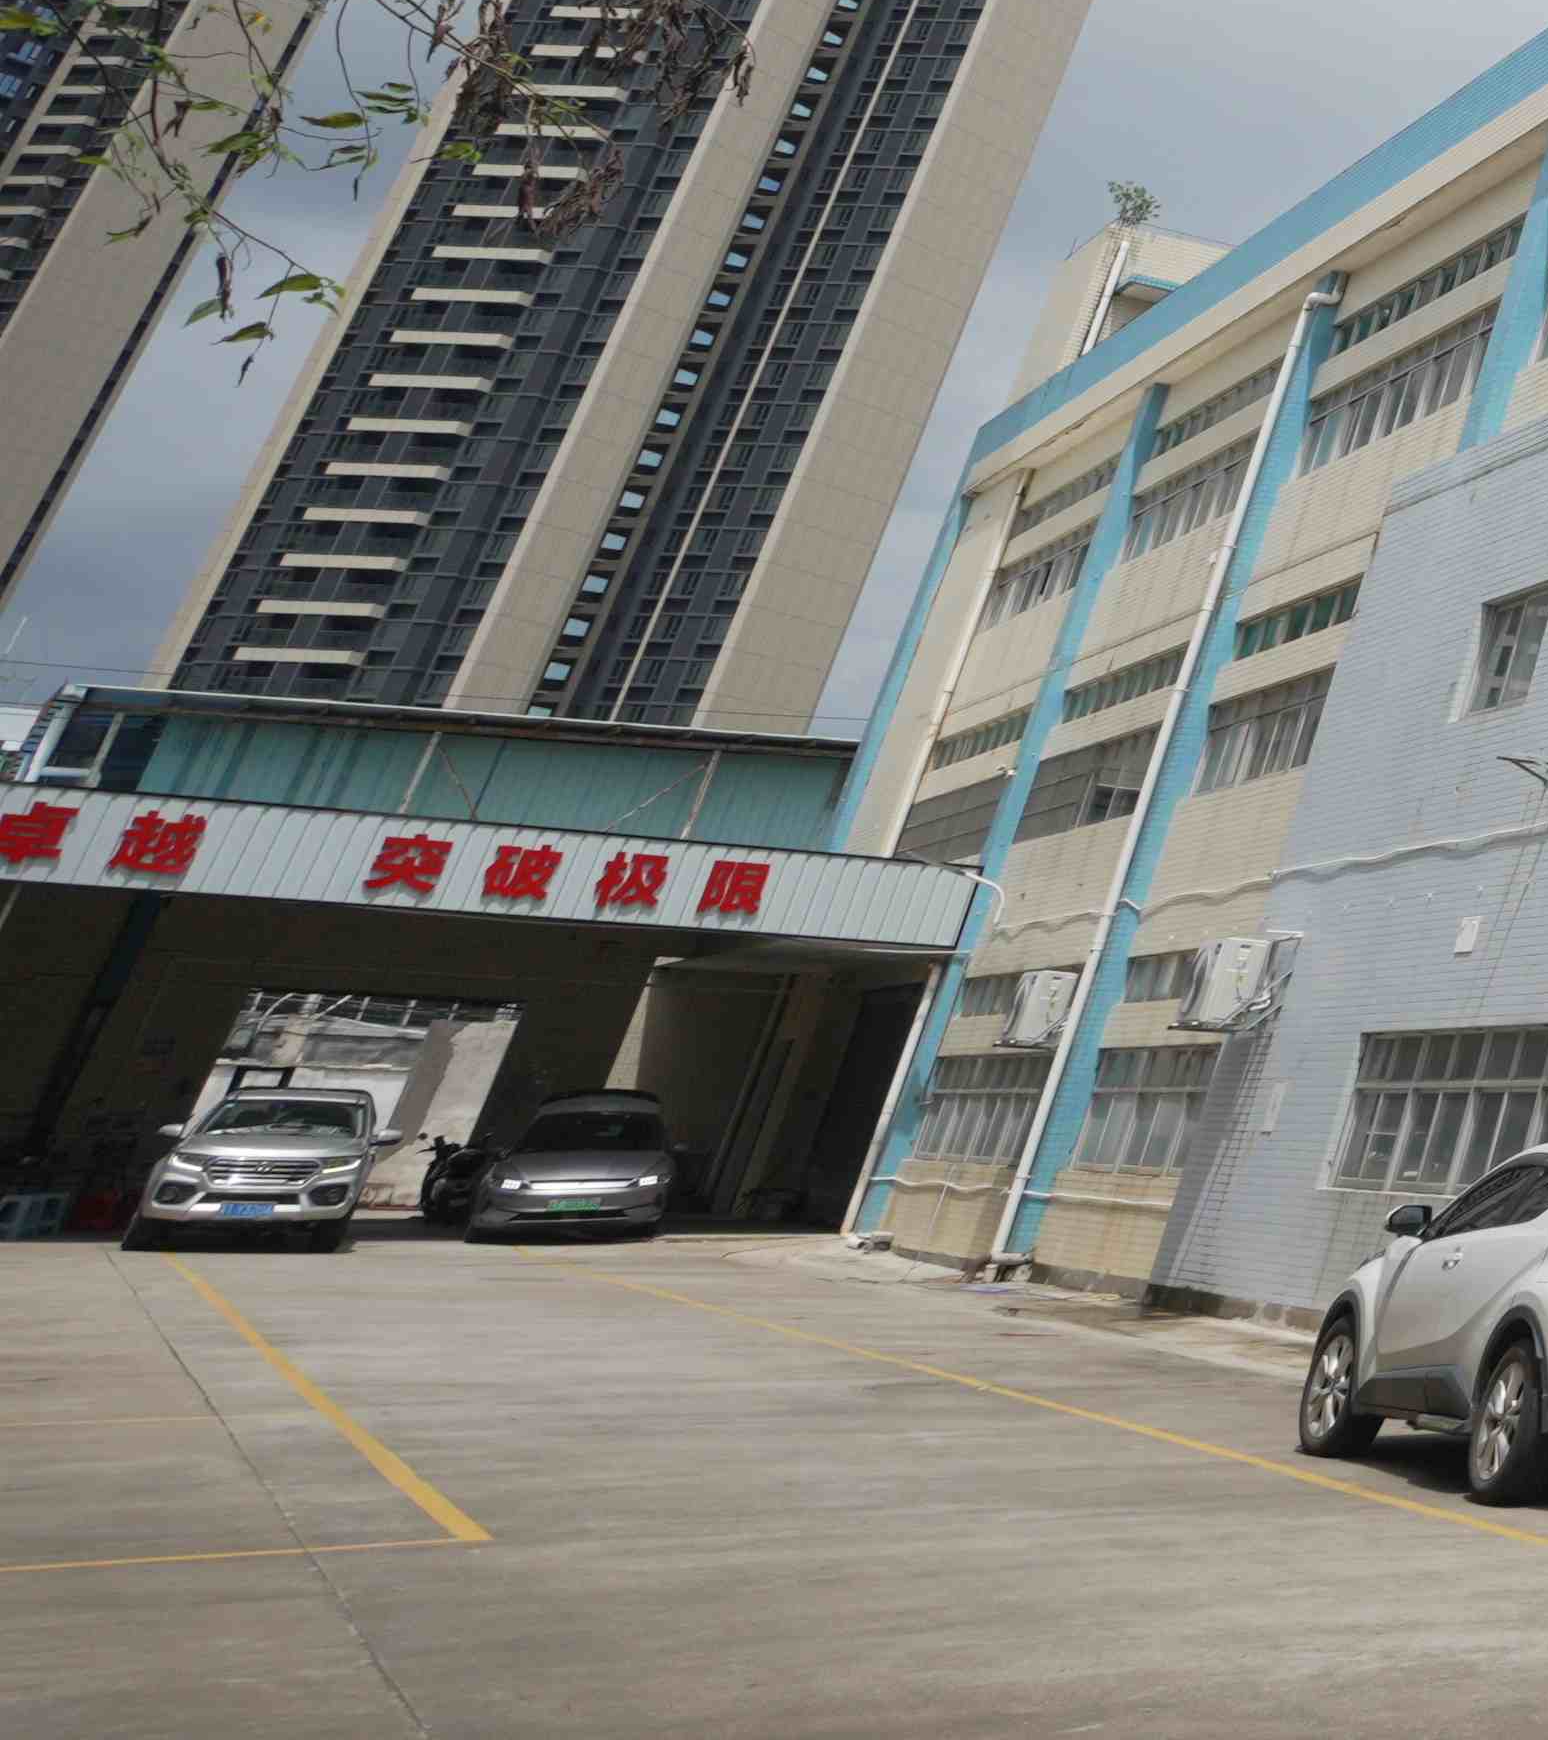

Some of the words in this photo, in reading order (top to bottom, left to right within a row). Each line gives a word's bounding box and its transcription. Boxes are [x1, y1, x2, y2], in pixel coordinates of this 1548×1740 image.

[0, 801, 207, 874] 卓越
[363, 834, 771, 915] 突破极限
